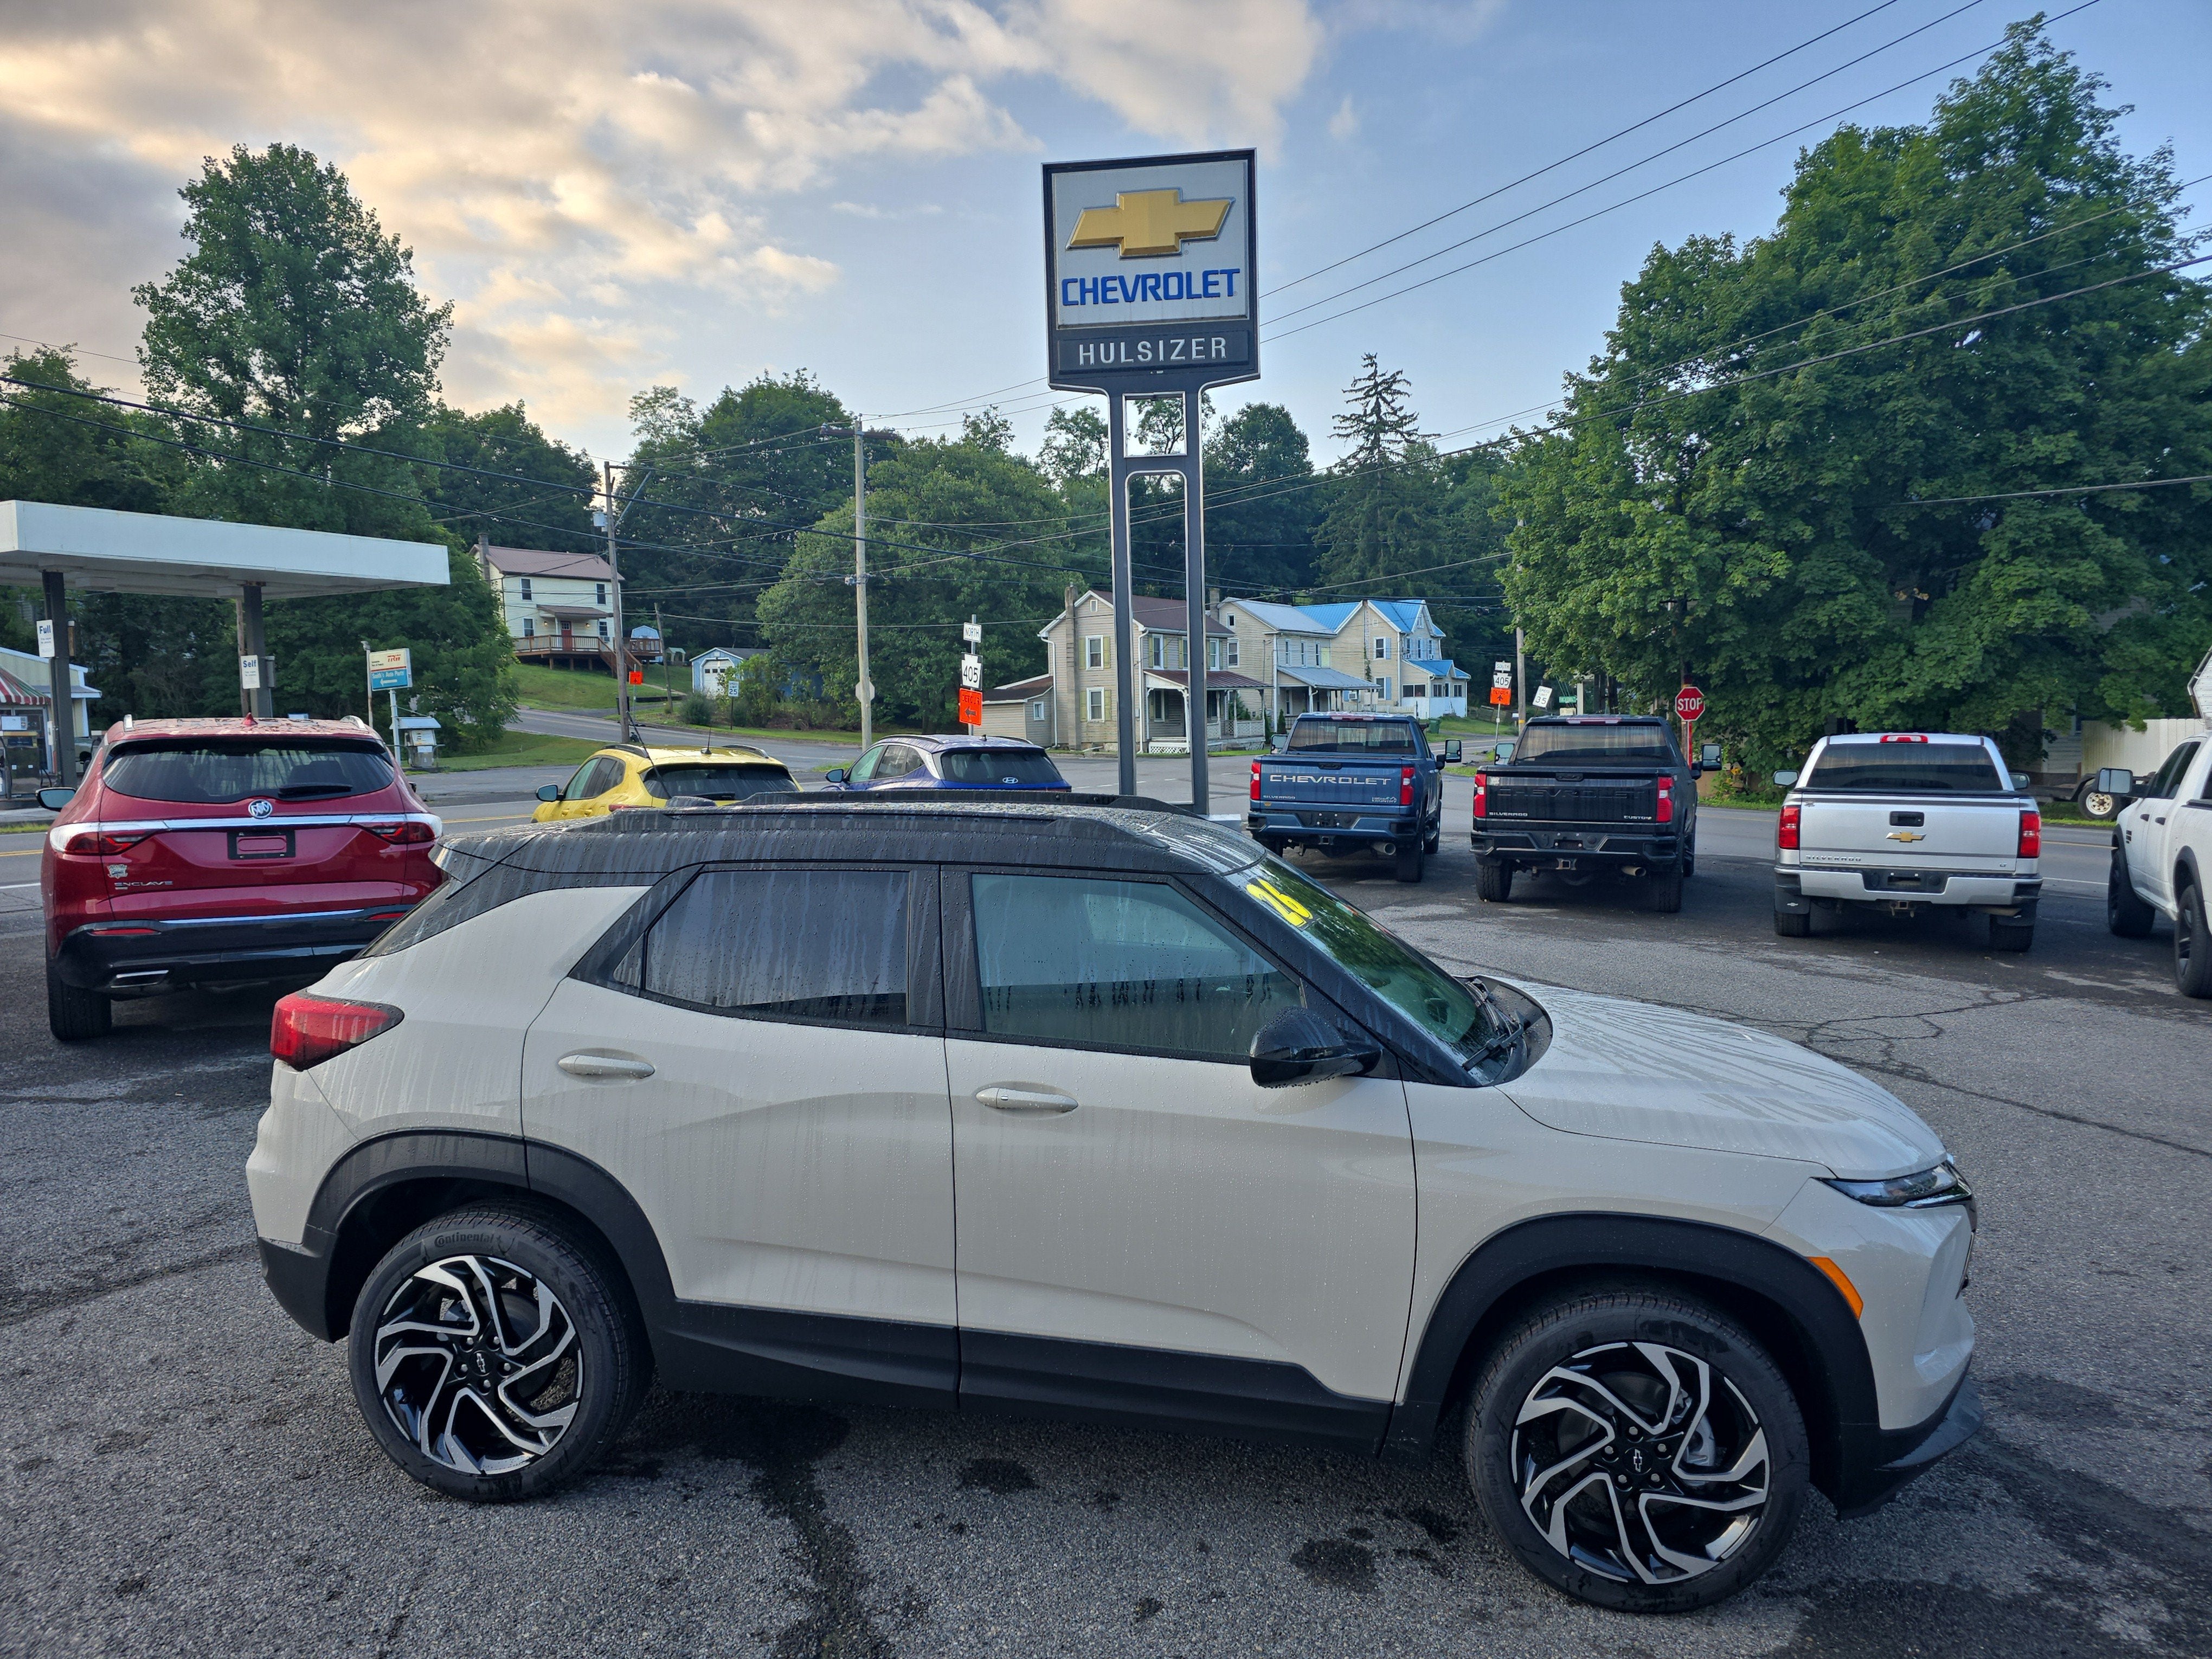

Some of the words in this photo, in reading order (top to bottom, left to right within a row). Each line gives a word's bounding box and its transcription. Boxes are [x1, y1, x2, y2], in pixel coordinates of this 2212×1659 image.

[1062, 268, 1240, 306] CHEVROLET
[1079, 337, 1227, 365] HULSIZER
[39, 625, 51, 634] Full
[965, 627, 980, 638] NORTH
[243, 659, 256, 668] Self
[963, 665, 979, 683] 405
[1495, 677, 1509, 686] 405
[961, 693, 980, 705] DETOUR
[1535, 696, 1547, 704] 35
[1677, 698, 1703, 711] STOP
[1270, 774, 1392, 786] CHEVROLET
[1246, 878, 1313, 928] 26
[435, 1232, 494, 1247] Continental
